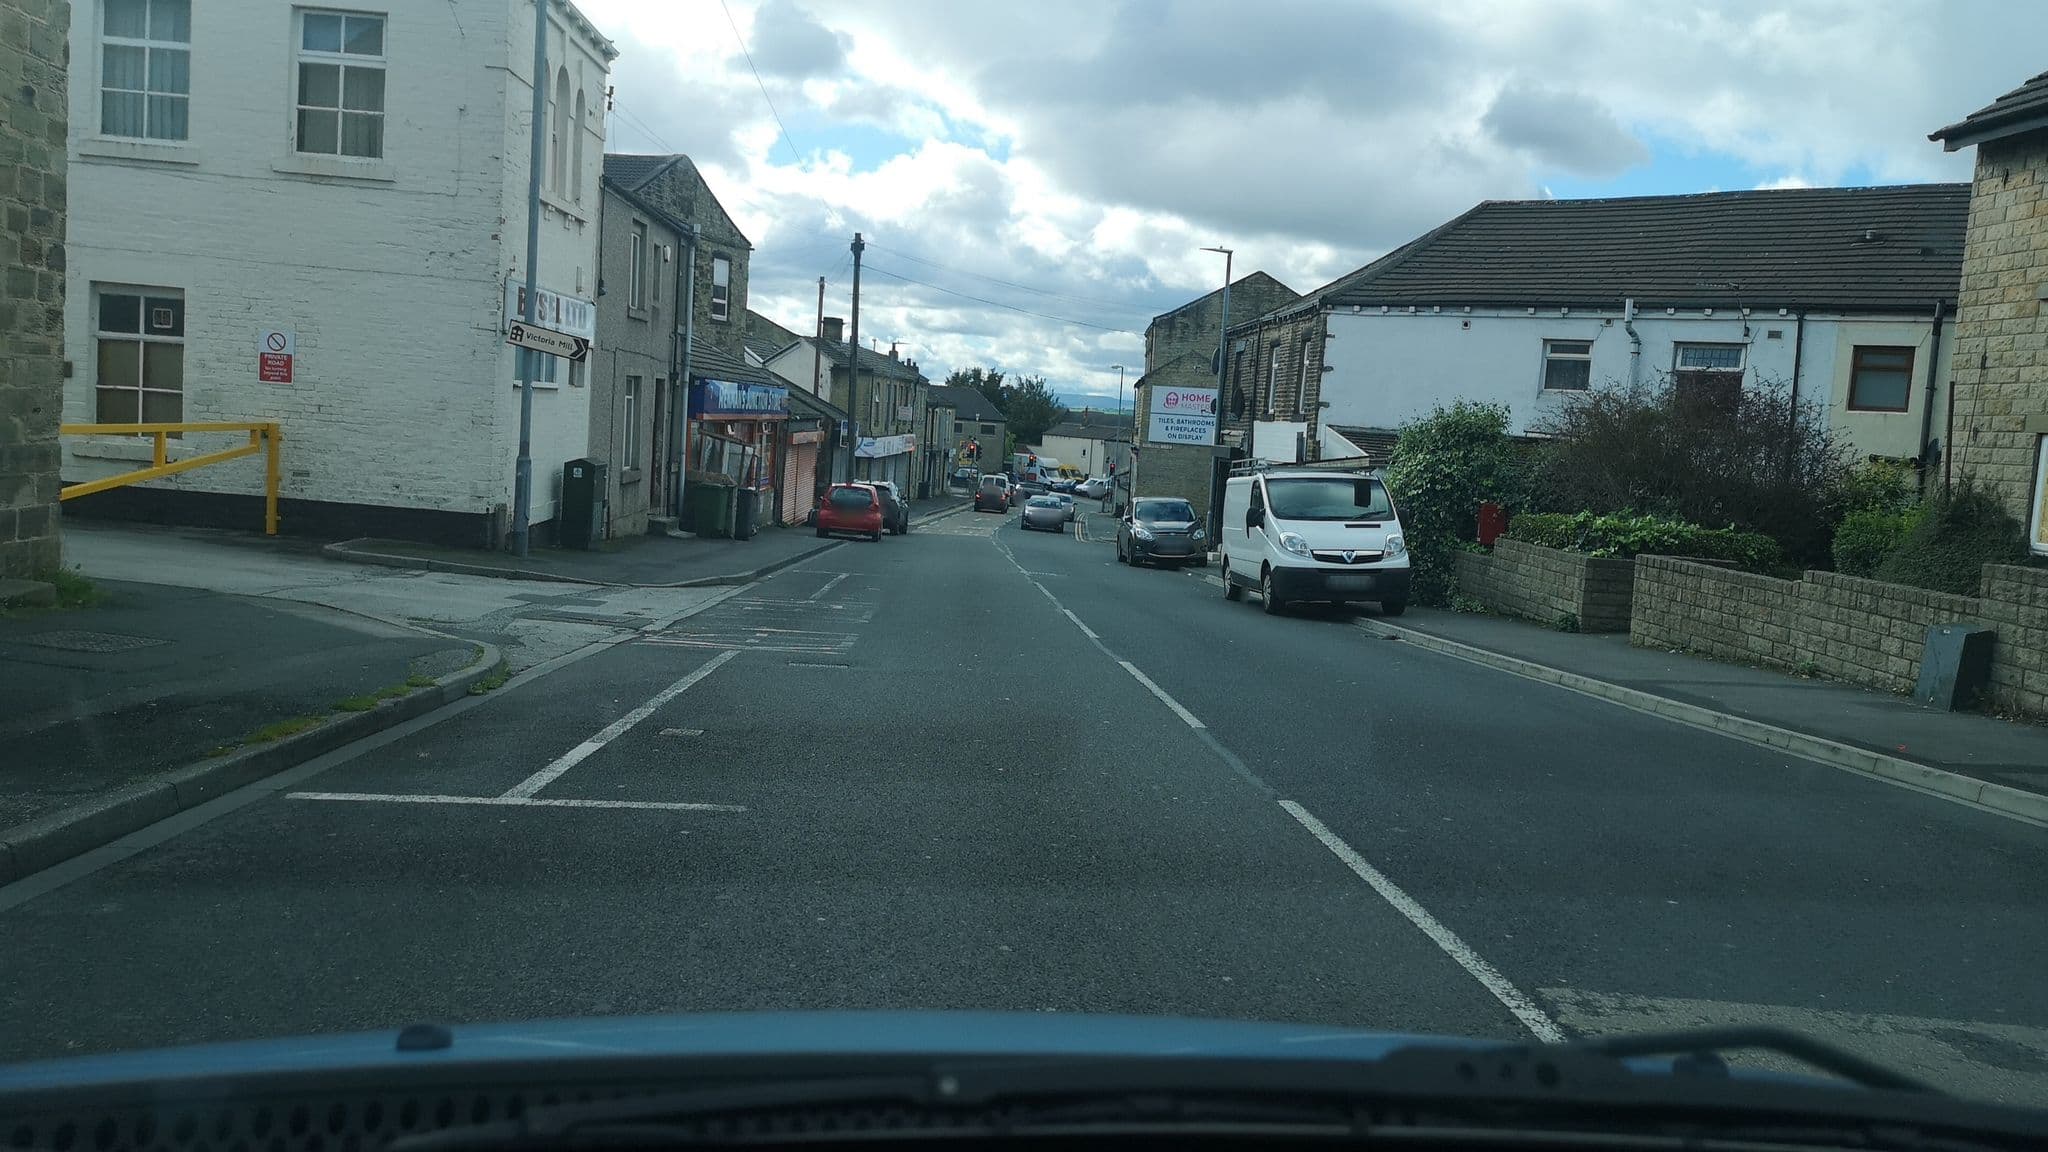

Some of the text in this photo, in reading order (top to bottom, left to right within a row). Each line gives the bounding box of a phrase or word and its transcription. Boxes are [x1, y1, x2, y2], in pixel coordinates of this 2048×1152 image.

[517, 287, 561, 324] BSEL
[526, 332, 574, 351] Victoria Mill
[1181, 393, 1211, 403] HOME
[1158, 417, 1215, 427] TILES, BATHROOMS
